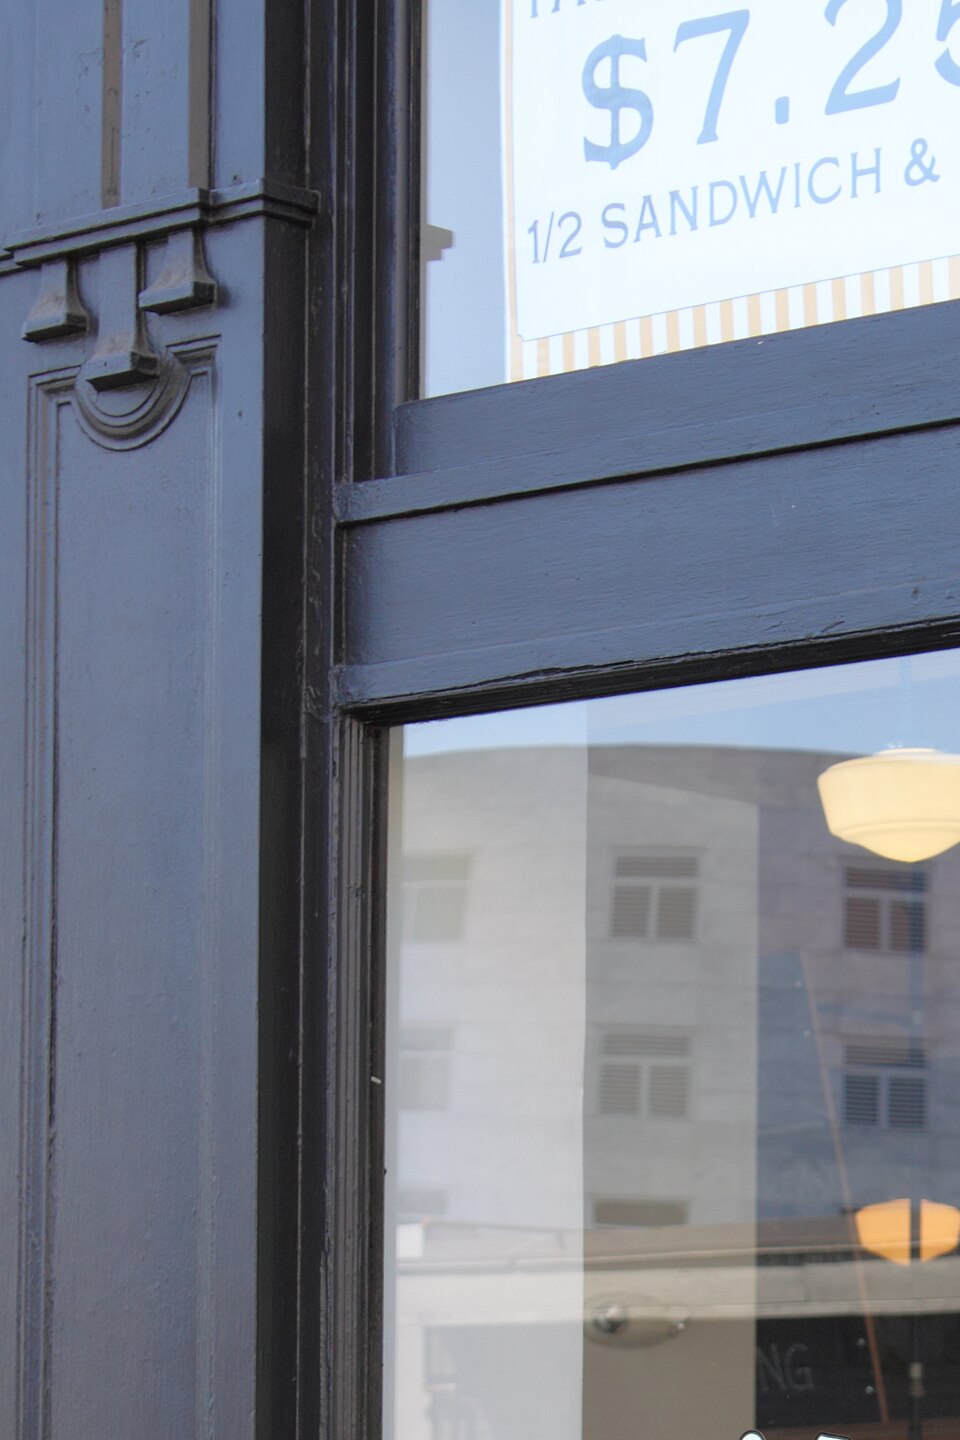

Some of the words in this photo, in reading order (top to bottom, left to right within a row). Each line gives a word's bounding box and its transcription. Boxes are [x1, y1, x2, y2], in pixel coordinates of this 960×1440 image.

[527, 210, 583, 264] 1/2
[601, 146, 882, 249] SANDWICH
[904, 138, 941, 188] &
